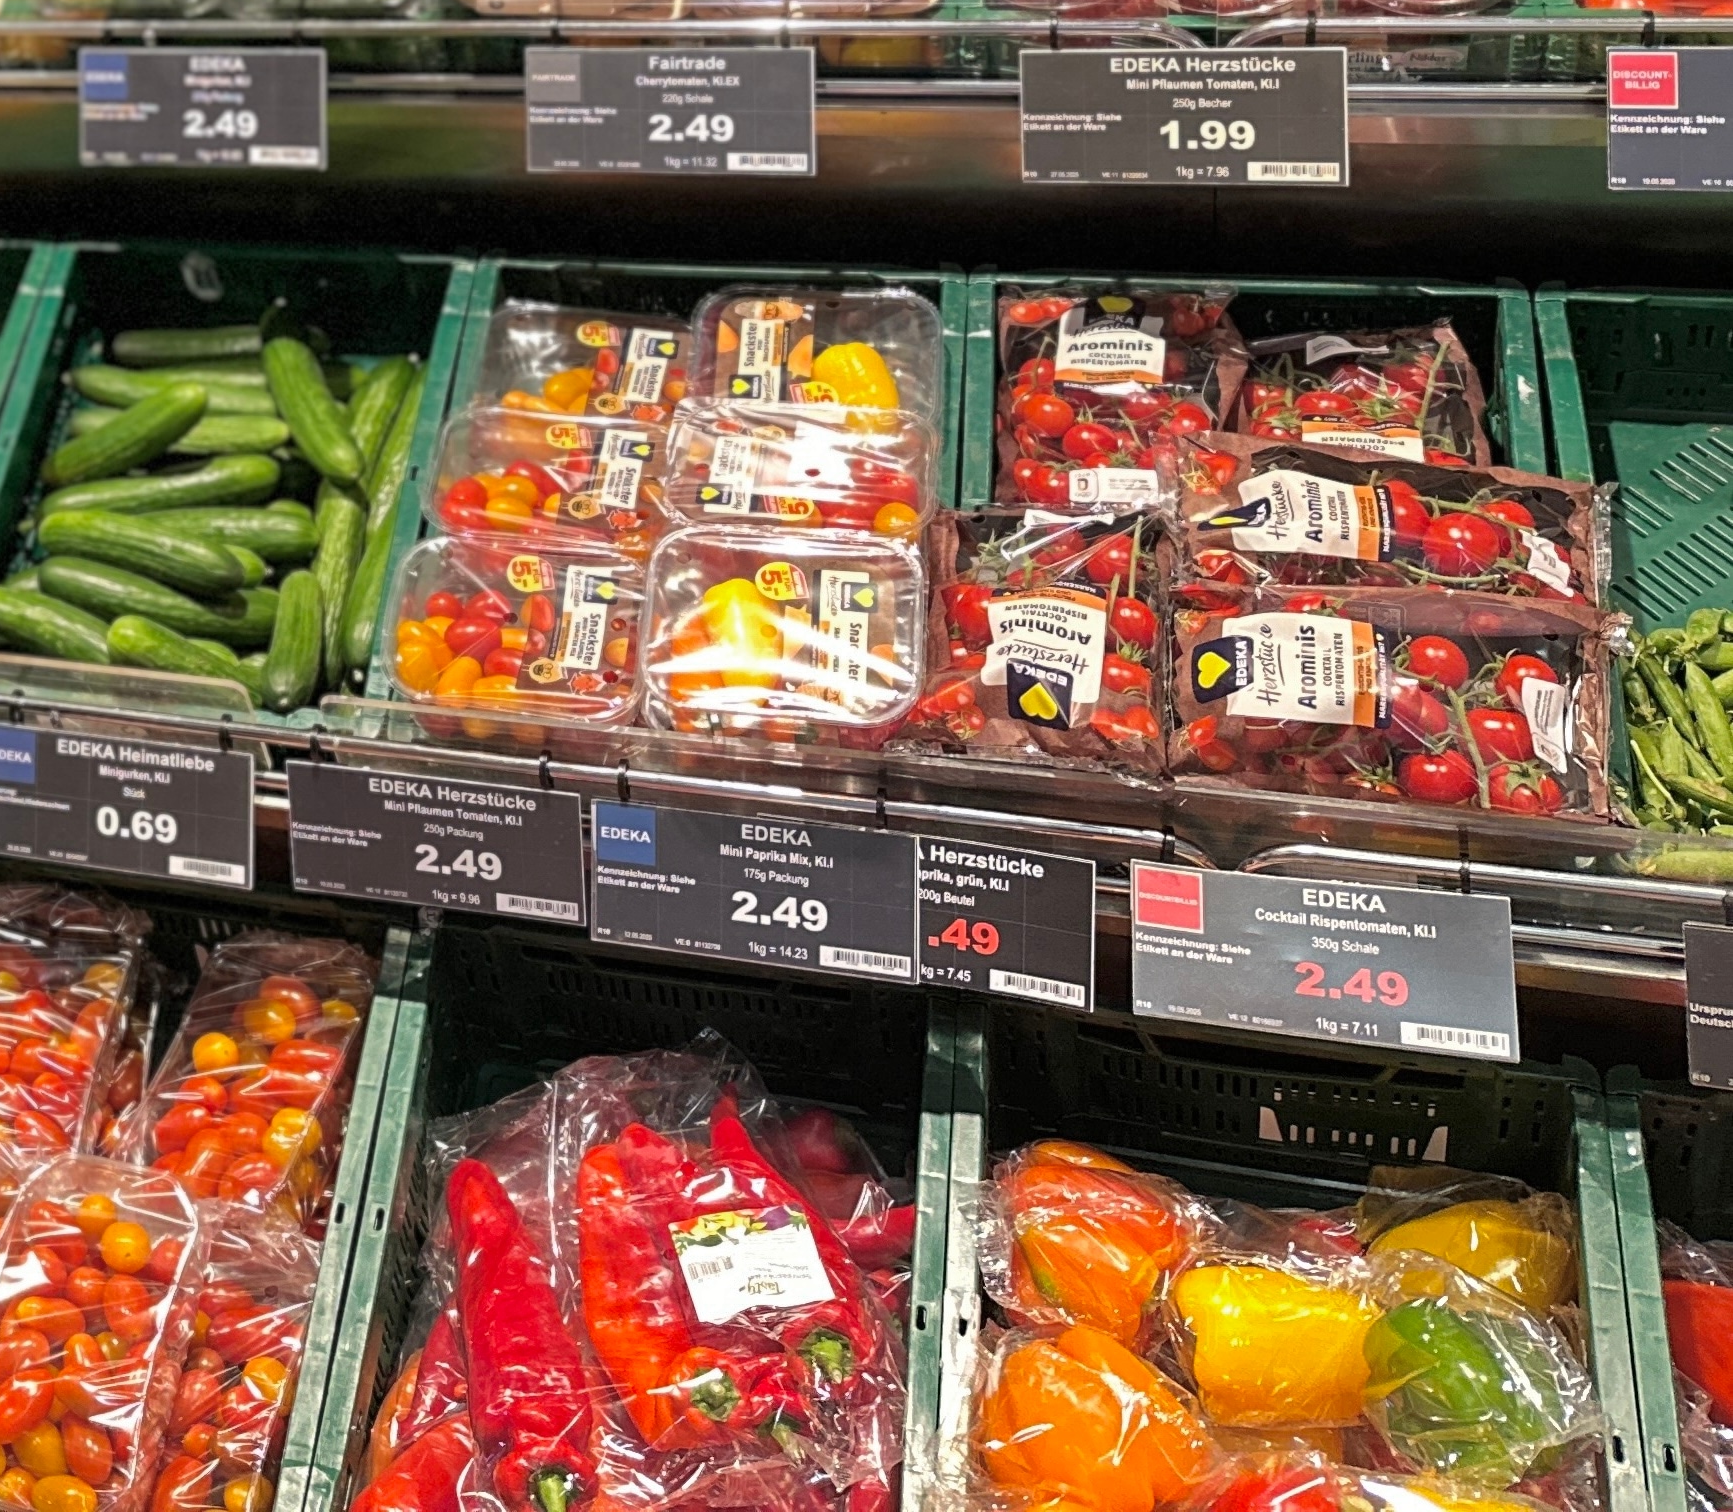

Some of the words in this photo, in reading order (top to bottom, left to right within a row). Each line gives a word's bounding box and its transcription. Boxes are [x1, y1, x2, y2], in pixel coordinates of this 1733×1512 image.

[189, 56, 246, 71] EDEKA
[648, 56, 726, 70] Fairtrade
[1109, 58, 1181, 73] EDEKA
[1186, 56, 1296, 73] Herzstücke
[532, 74, 576, 82] FAIRTRADE
[635, 76, 710, 88] Cherrytomaten,
[1126, 79, 1149, 90] Mini
[1153, 79, 1203, 90] Pflaumen
[1206, 79, 1257, 91] Tomaten,
[1613, 71, 1672, 79] DISCOUNT-
[1625, 81, 1660, 89] BILLIG
[662, 94, 683, 105] 220g
[685, 94, 713, 104] Schale
[1173, 98, 1195, 110] 250g
[1198, 98, 1232, 108] Becher
[182, 109, 258, 138] 2.49
[1023, 113, 1094, 122] Kennzeichnung:
[1096, 113, 1122, 121] Siehe
[1023, 123, 1051, 131] Etikett
[1066, 123, 1082, 131] der
[1083, 123, 1106, 131] Ware
[1611, 115, 1693, 124] Kennzeichnung:
[1696, 115, 1725, 124] Siehe
[648, 114, 734, 142] 2.49
[1160, 120, 1256, 150] 1.99
[1611, 125, 1643, 133] Etikett
[1680, 126, 1707, 134] Ware
[664, 157, 681, 169] 1kg
[692, 157, 717, 167] 11.32
[1176, 167, 1194, 179] 1kg
[1207, 167, 1229, 177] 7.96
[744, 322, 757, 367] Snackster
[1067, 339, 1153, 353] Arominis
[1301, 479, 1323, 543] Arominis
[1021, 609, 1067, 623] COCKTAIL
[582, 613, 602, 666] Snackster
[999, 618, 1091, 646] Arominis
[848, 622, 862, 681] Snacter
[996, 643, 1089, 675] Herzstücke
[1235, 640, 1248, 686] EDEKA
[1294, 624, 1317, 709] Arominis
[1322, 648, 1333, 687] COCKTAIL
[1334, 633, 1345, 706] RISPENTOMATEN
[1012, 662, 1068, 687] EDEKA
[57, 739, 115, 760] EDEKA
[119, 746, 215, 772] Heimatliebe
[99, 764, 152, 783] Minigurken,
[123, 787, 146, 799] Stück
[368, 777, 432, 800] EDEKA
[437, 786, 537, 811] Herzstücke
[384, 799, 405, 812] Mini
[408, 802, 454, 819] Pflaumen
[456, 808, 502, 826] Tomaten,
[96, 806, 177, 844] 0.69
[424, 823, 444, 836] 250g
[446, 826, 484, 842] Packung
[601, 825, 651, 844] EDEKA
[332, 835, 345, 844] der
[347, 837, 368, 847] Ware
[741, 824, 812, 847] EDEKA
[414, 844, 502, 881] 2.49
[720, 844, 743, 859] Mini
[745, 846, 787, 864] Paprika
[790, 851, 812, 868] Mix,
[930, 845, 1044, 878] Herzstücke
[597, 865, 669, 883] Kennzeichnung:
[671, 874, 696, 885] Siehe
[743, 867, 766, 883] 175g
[769, 870, 809, 887] Packung
[957, 874, 986, 890] grün,
[432, 889, 449, 903] 1kg
[641, 880, 656, 891] der
[657, 882, 680, 894] Ware
[919, 888, 941, 904] 200g
[943, 891, 975, 906] Beutel
[731, 890, 828, 932] 2.49
[1302, 888, 1386, 914] EDEKA
[1254, 907, 1307, 927] Cocktail
[1310, 913, 1411, 937] Rispentomaten,
[928, 918, 999, 955] .49
[1135, 931, 1219, 952] Kennzeichnung:
[1221, 942, 1251, 956] Siehe
[1311, 936, 1339, 953] 350g
[1341, 939, 1380, 955] Schale
[749, 941, 766, 956] 1kg
[779, 944, 808, 960] 14.23
[1135, 942, 1169, 957] Etikett
[1186, 949, 1204, 961] der
[1206, 951, 1233, 964] Ware
[921, 964, 933, 978] kg
[947, 967, 971, 982] 7.45
[1294, 960, 1409, 1006] 2.49
[1315, 1016, 1338, 1034] 1kg
[1352, 1021, 1379, 1037] 7.11
